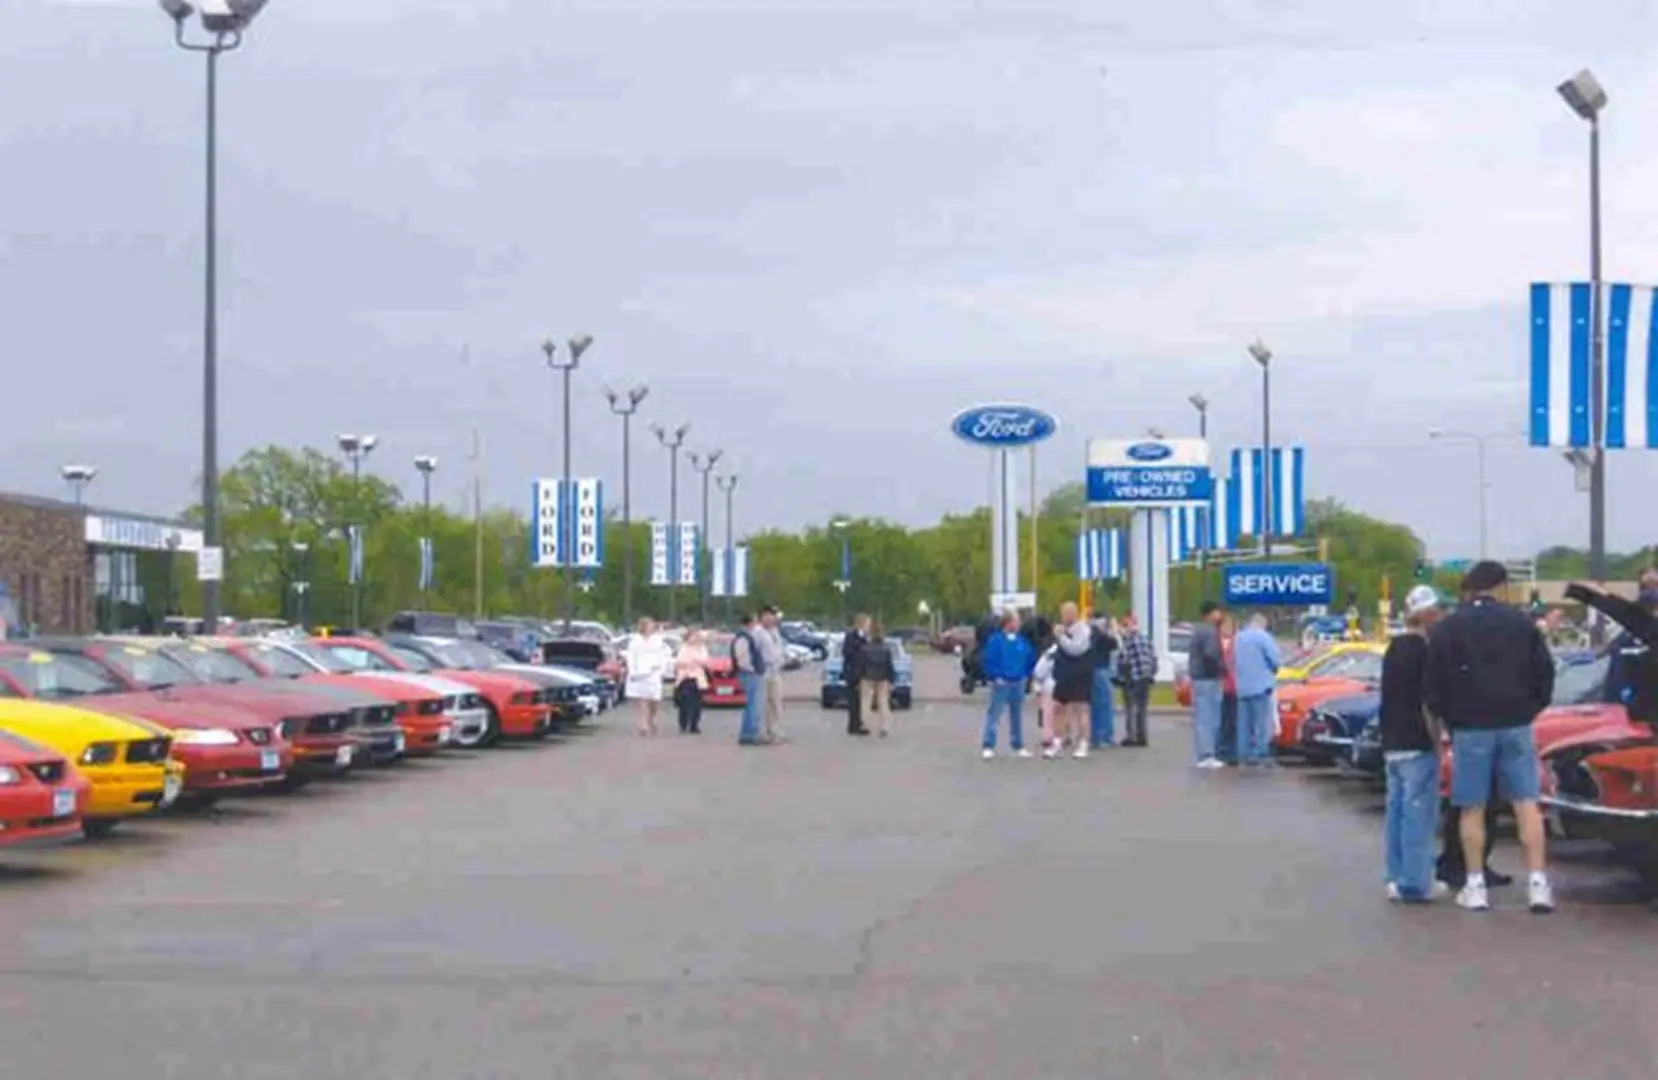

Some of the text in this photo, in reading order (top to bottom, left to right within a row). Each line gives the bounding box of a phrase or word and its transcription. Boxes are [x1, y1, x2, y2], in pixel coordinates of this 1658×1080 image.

[972, 412, 1035, 438] Ford
[1114, 485, 1187, 498] VEHICLES
[541, 487, 556, 556] FORD
[580, 487, 595, 556] FORD
[1229, 573, 1326, 594] SERVICE
